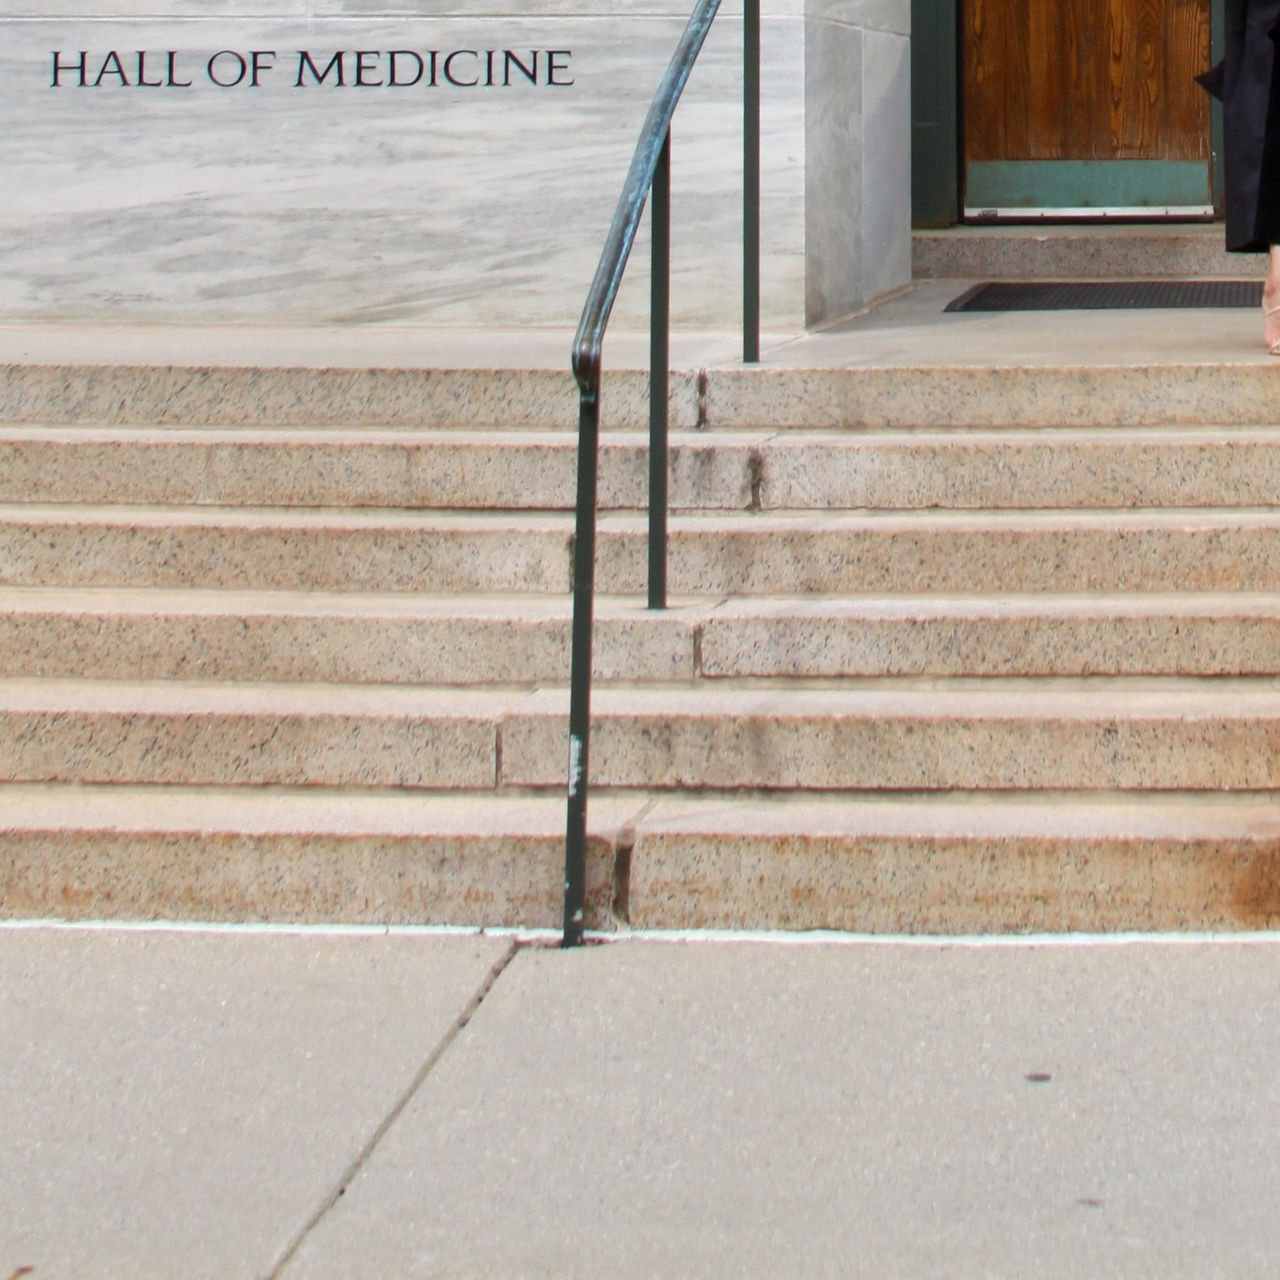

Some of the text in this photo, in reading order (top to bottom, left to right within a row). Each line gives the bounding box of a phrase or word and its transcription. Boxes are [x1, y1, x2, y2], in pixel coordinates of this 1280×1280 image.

[49, 49, 575, 88] HALL OF MEDICINE
